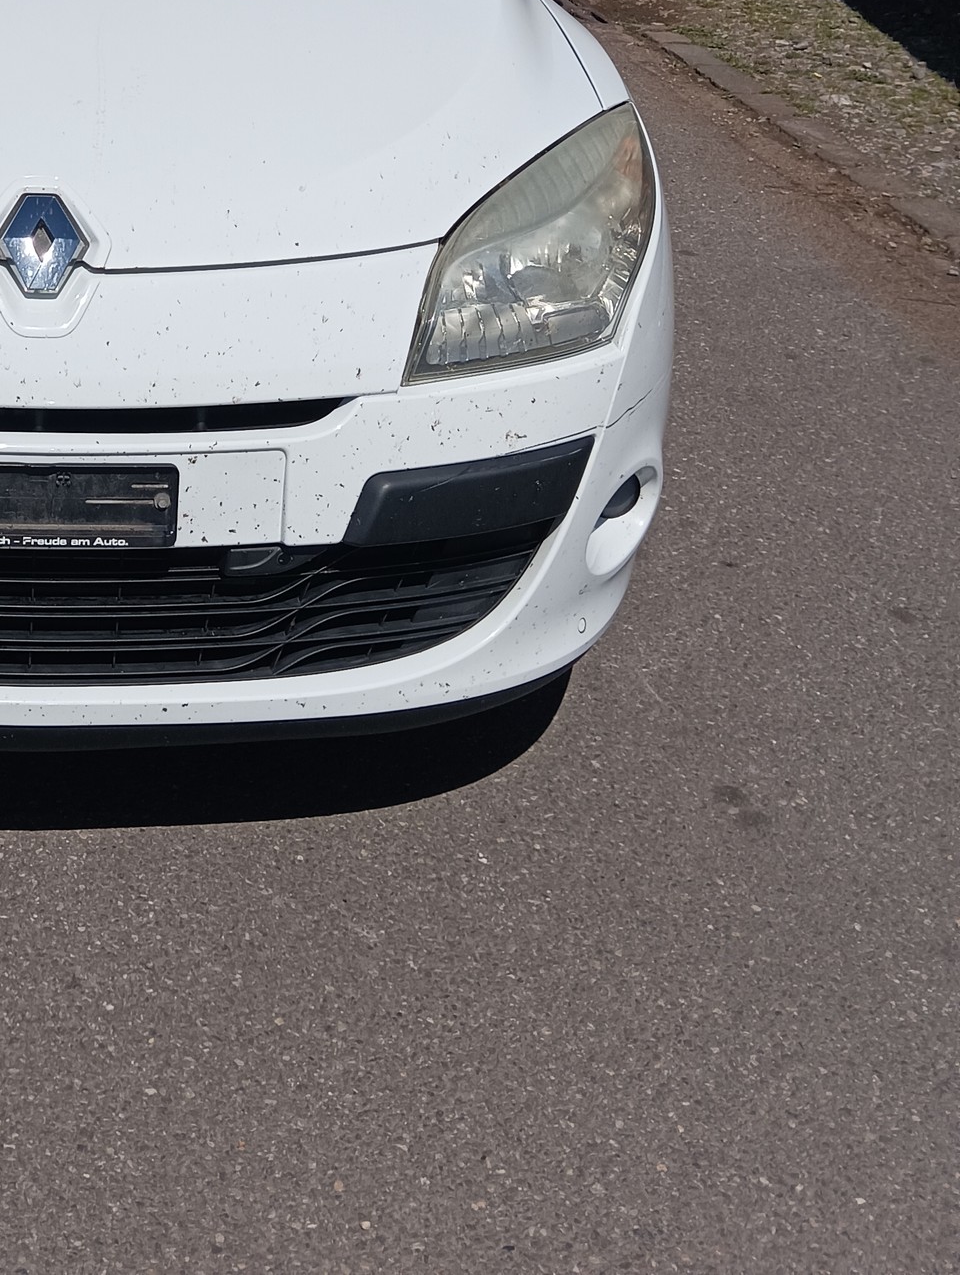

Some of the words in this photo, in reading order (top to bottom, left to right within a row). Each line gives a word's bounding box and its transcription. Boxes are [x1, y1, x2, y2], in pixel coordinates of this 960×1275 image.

[22, 536, 67, 546] Freude
[70, 538, 90, 546] am
[93, 537, 129, 546] Auto.
